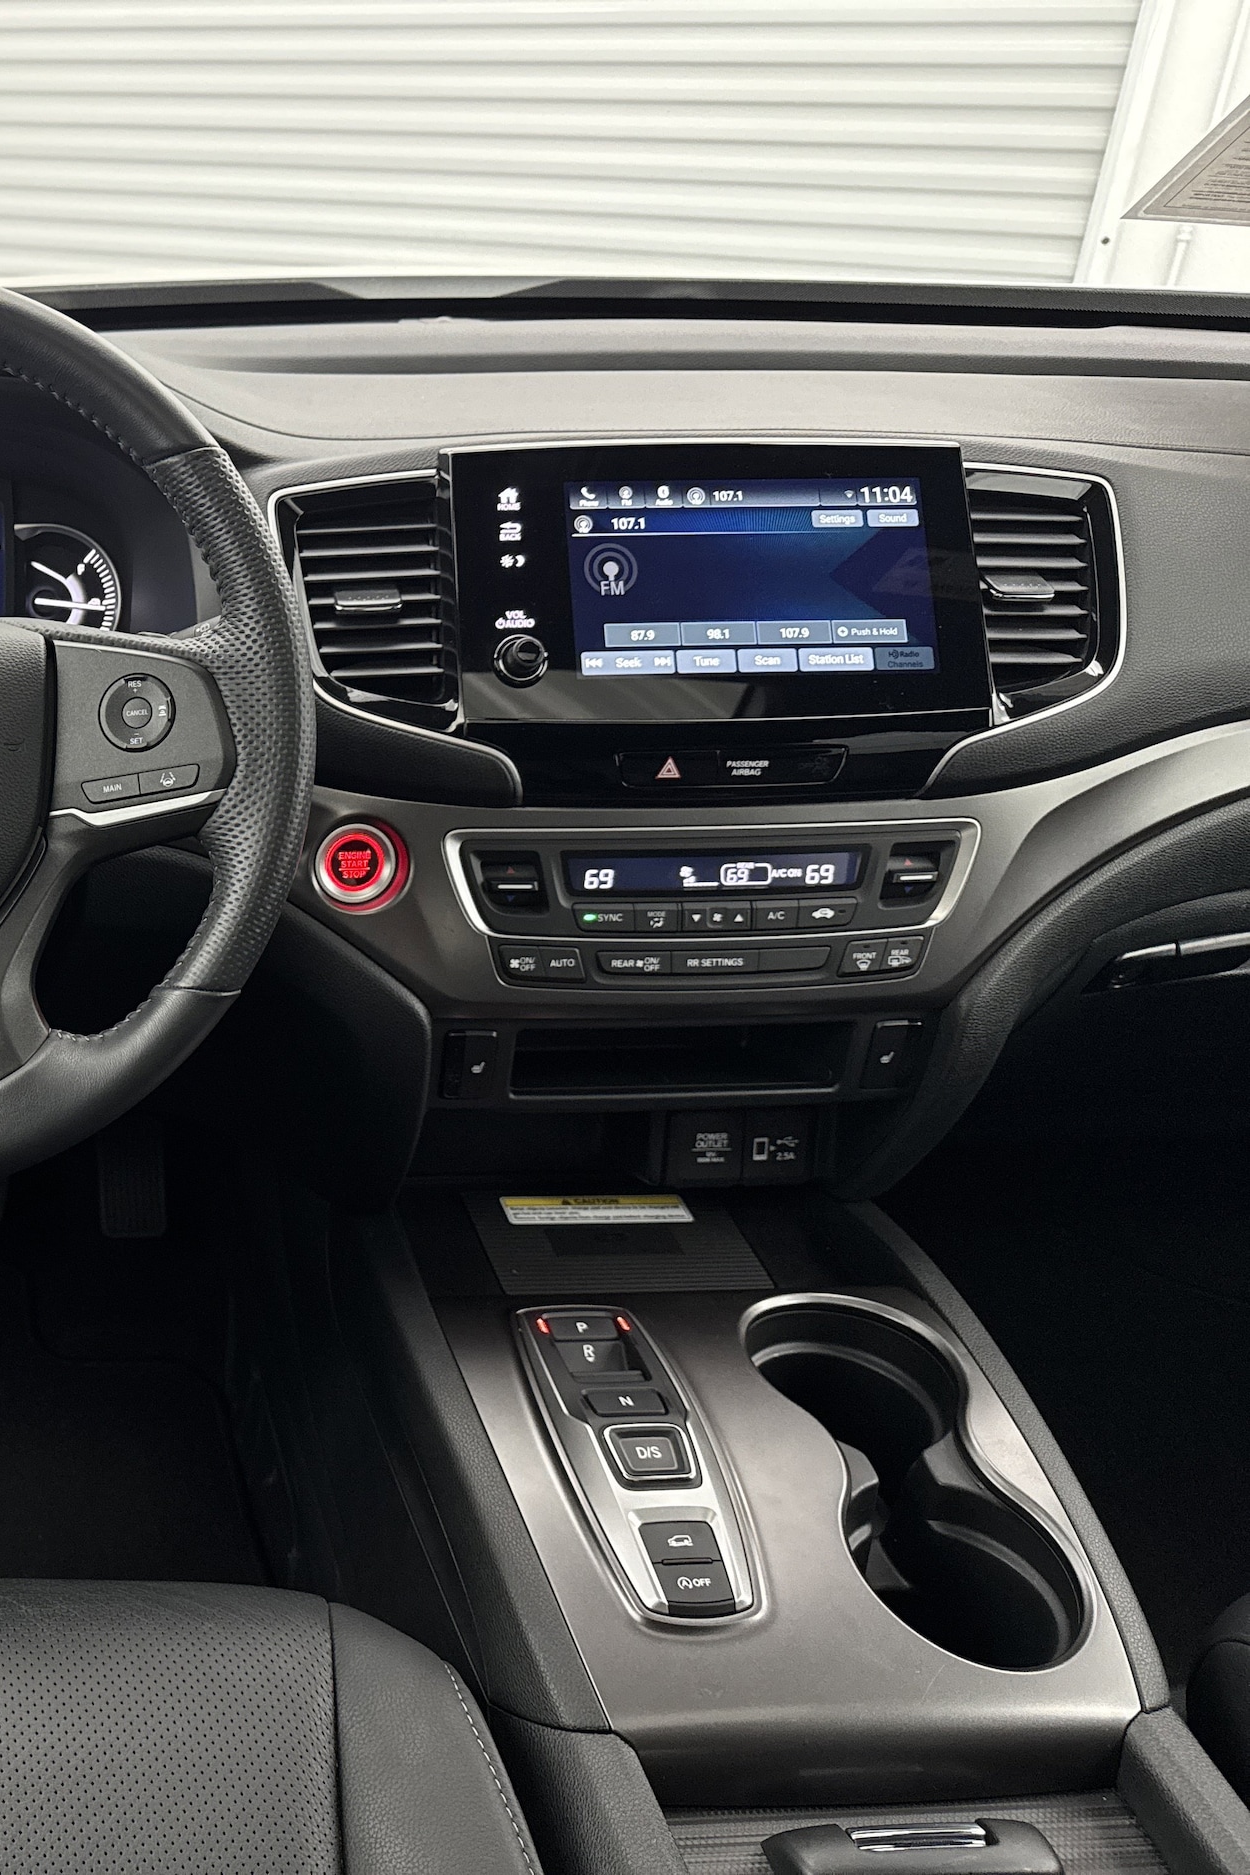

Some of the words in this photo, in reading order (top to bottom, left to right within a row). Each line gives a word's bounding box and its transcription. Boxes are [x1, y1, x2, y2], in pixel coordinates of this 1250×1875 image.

[713, 490, 743, 502] 107.1
[860, 486, 913, 503] 11:04
[497, 502, 521, 511] HOME
[819, 513, 856, 525] Settings
[879, 513, 908, 524] Sound
[611, 517, 645, 531] 107.1
[499, 532, 521, 541] BACK
[600, 581, 626, 596] FM
[505, 610, 526, 620] VOL
[505, 618, 535, 628] AUDIO
[630, 629, 655, 641] 87.9
[706, 628, 730, 640] 98.1
[779, 627, 810, 639] 107.9
[851, 628, 870, 636] Push
[872, 628, 879, 636] &
[881, 627, 898, 636] Hold
[808, 653, 843, 665] Station
[845, 652, 864, 664] List
[900, 650, 919, 658] Radio
[615, 657, 642, 668] Seek
[693, 655, 721, 667] Tune
[754, 655, 781, 666] Scan
[887, 660, 924, 669] Channels
[126, 709, 149, 717] CANCEL
[130, 737, 143, 745] SET
[726, 760, 769, 768] PASSENGER
[731, 768, 762, 776] AIRBAG
[103, 783, 122, 793] MAIN
[338, 851, 371, 860] ENGINE
[341, 860, 368, 868] START
[342, 870, 366, 879] STOP
[583, 868, 615, 889] 69
[725, 868, 749, 883] 69
[804, 864, 835, 885] 69
[597, 913, 623, 923] SYNC
[767, 911, 785, 921] A/C
[519, 956, 536, 964] ON/
[643, 956, 660, 964] ON/
[852, 952, 877, 960] FRONT
[550, 958, 575, 968] AUTO
[611, 959, 634, 968] REAR
[686, 958, 699, 967] RR
[701, 957, 743, 968] SETTINGS
[519, 964, 536, 972] OFF
[643, 964, 660, 972] OFF
[696, 1132, 728, 1141] POWER
[695, 1140, 727, 1148] OUTLET
[575, 1321, 588, 1333] P
[582, 1343, 595, 1358] R
[618, 1395, 634, 1407] N
[635, 1445, 663, 1460] D/S
[692, 1576, 712, 1588] OFF
